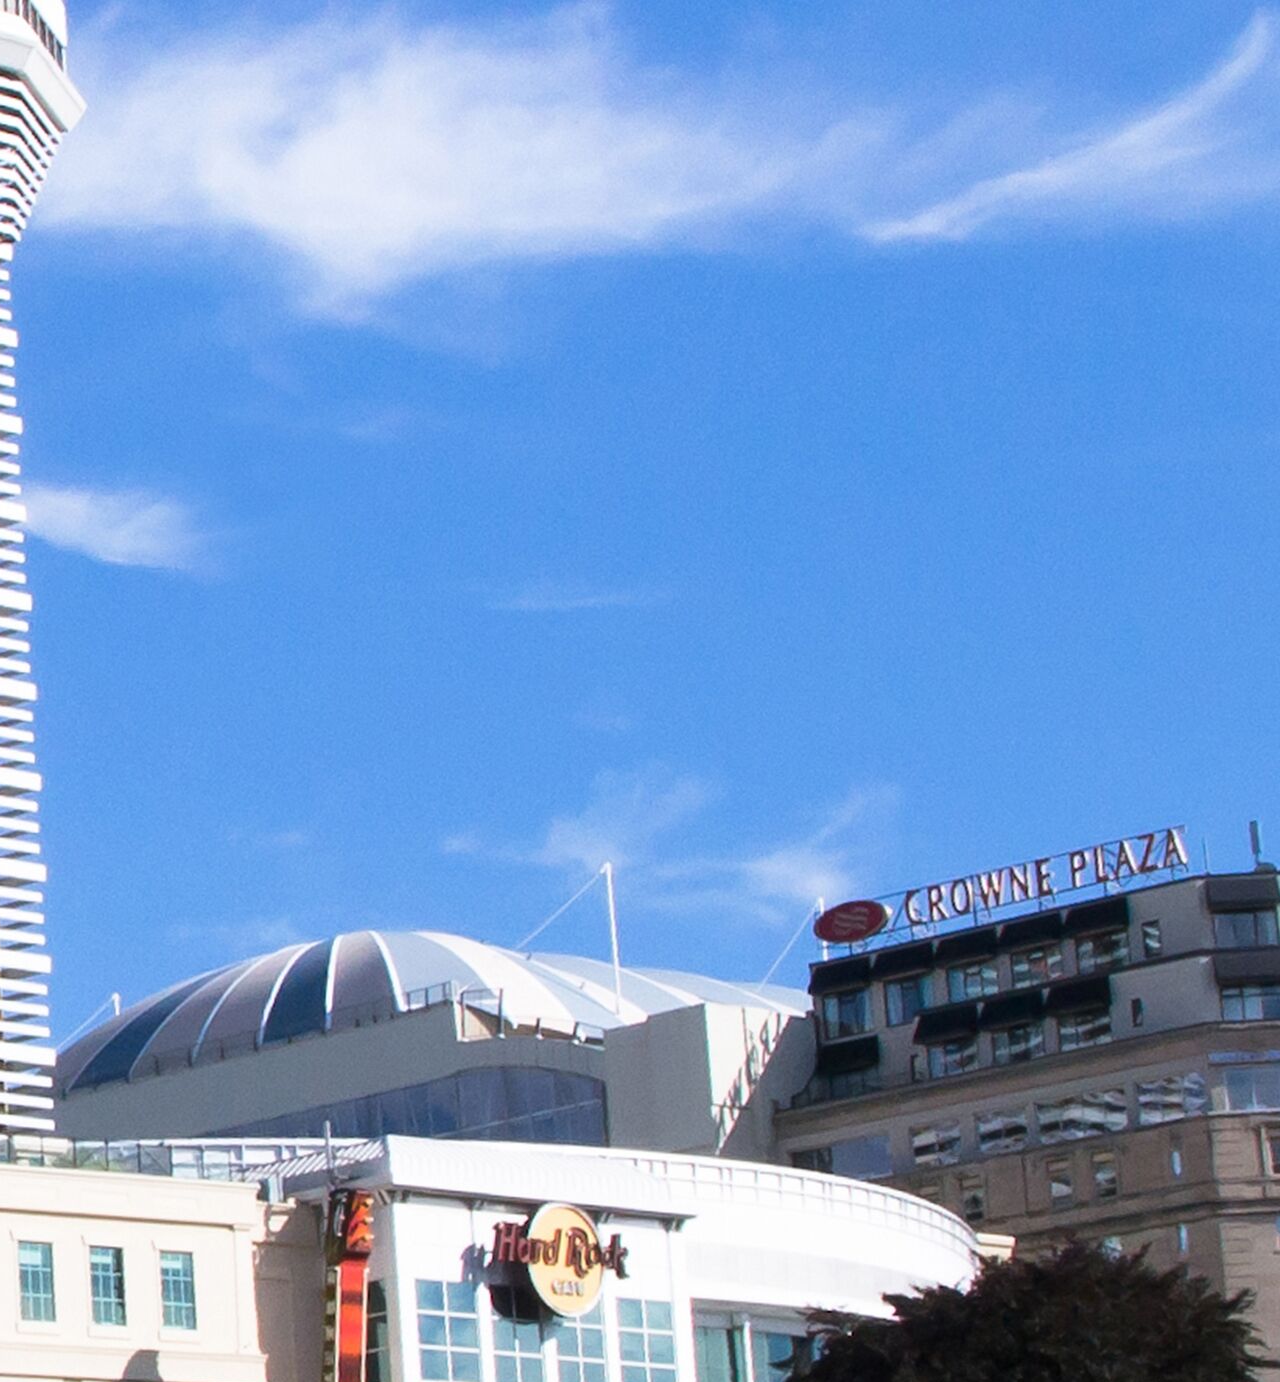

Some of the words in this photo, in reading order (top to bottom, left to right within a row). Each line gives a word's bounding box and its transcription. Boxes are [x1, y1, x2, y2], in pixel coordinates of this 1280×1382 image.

[904, 858, 1056, 926] CROWNE
[1068, 827, 1189, 888] PLAZA
[493, 1221, 563, 1266] Hard
[565, 1226, 629, 1280] Rock
